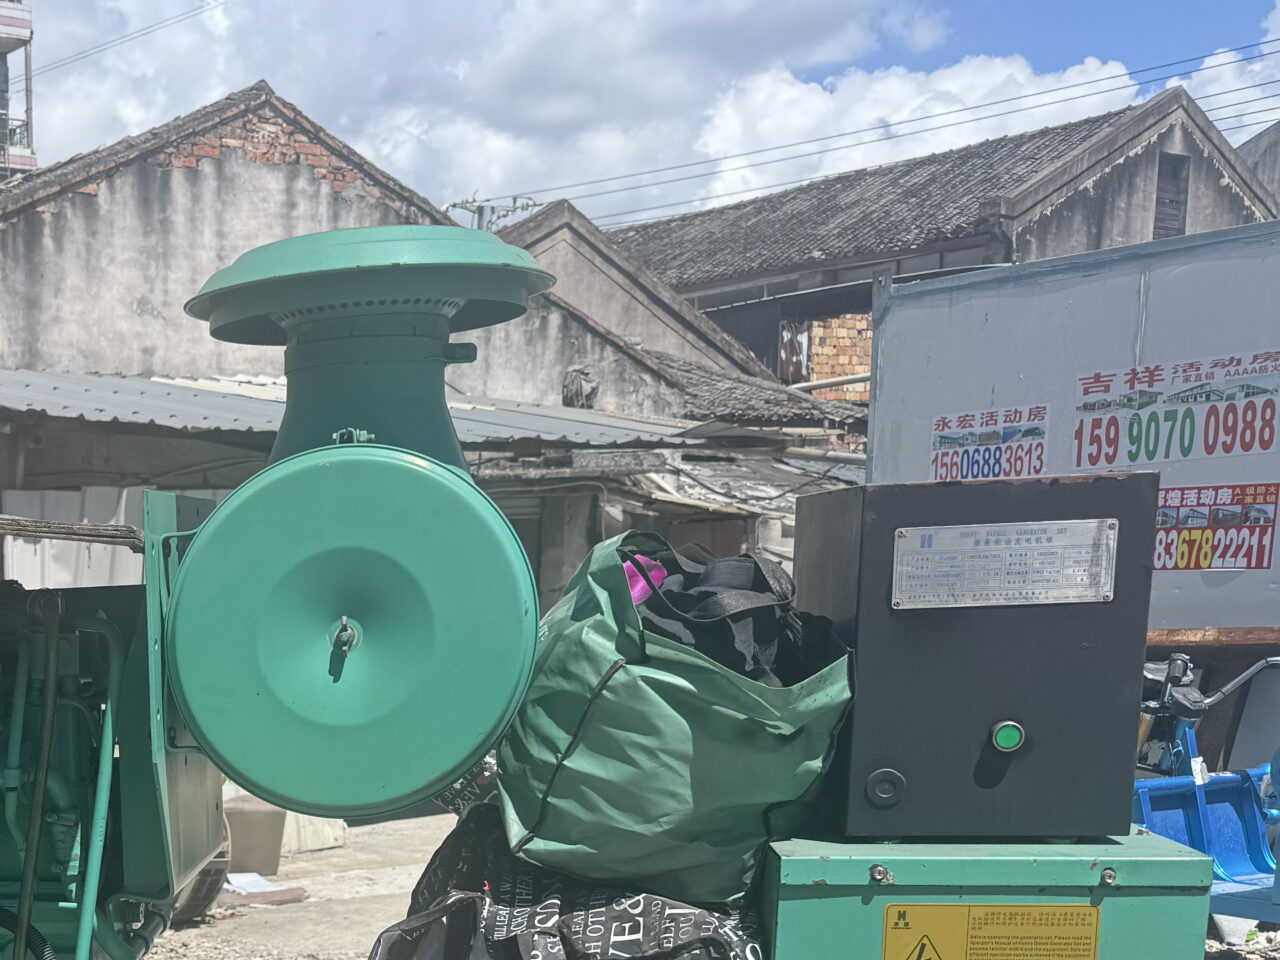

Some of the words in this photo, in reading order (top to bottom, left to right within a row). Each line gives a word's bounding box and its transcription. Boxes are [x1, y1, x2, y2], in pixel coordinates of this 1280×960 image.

[934, 405, 1047, 432] 永宏活动房
[1074, 415, 1120, 467] 159
[1127, 407, 1196, 463] 9070
[1203, 398, 1276, 456] 0988
[931, 442, 1045, 480] 15606883613
